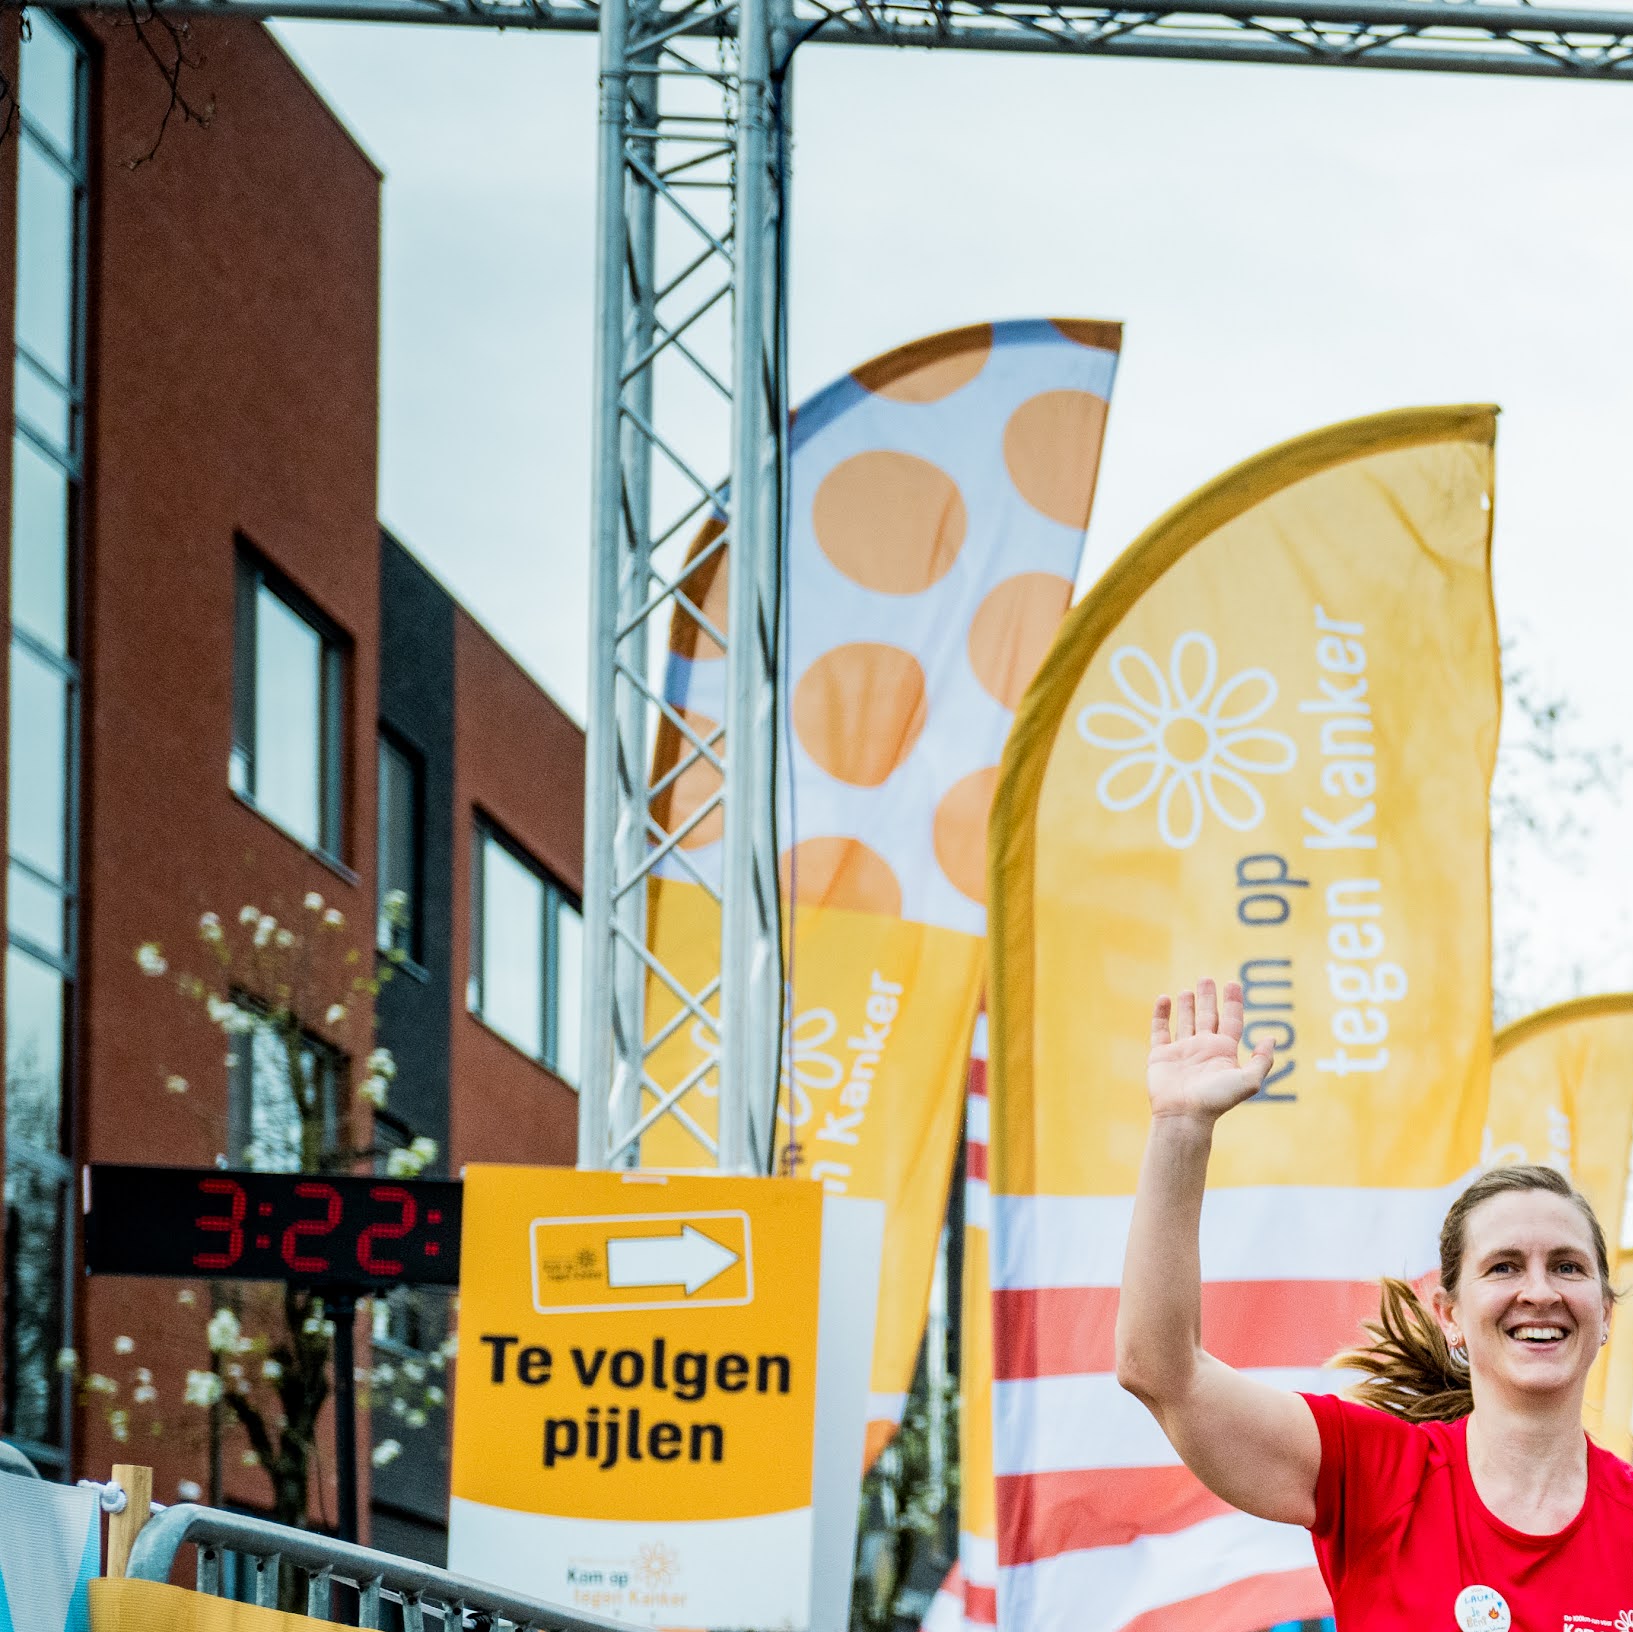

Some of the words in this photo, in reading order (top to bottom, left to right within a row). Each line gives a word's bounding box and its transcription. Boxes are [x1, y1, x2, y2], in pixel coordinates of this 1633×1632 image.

[1297, 603, 1379, 850] Kanker
[1236, 851, 1311, 927] op
[1316, 877, 1409, 1077] tegen
[816, 969, 905, 1147] Kanker
[479, 1334, 553, 1386] Te
[570, 1337, 790, 1402] volgen
[543, 1407, 724, 1470] pijlen
